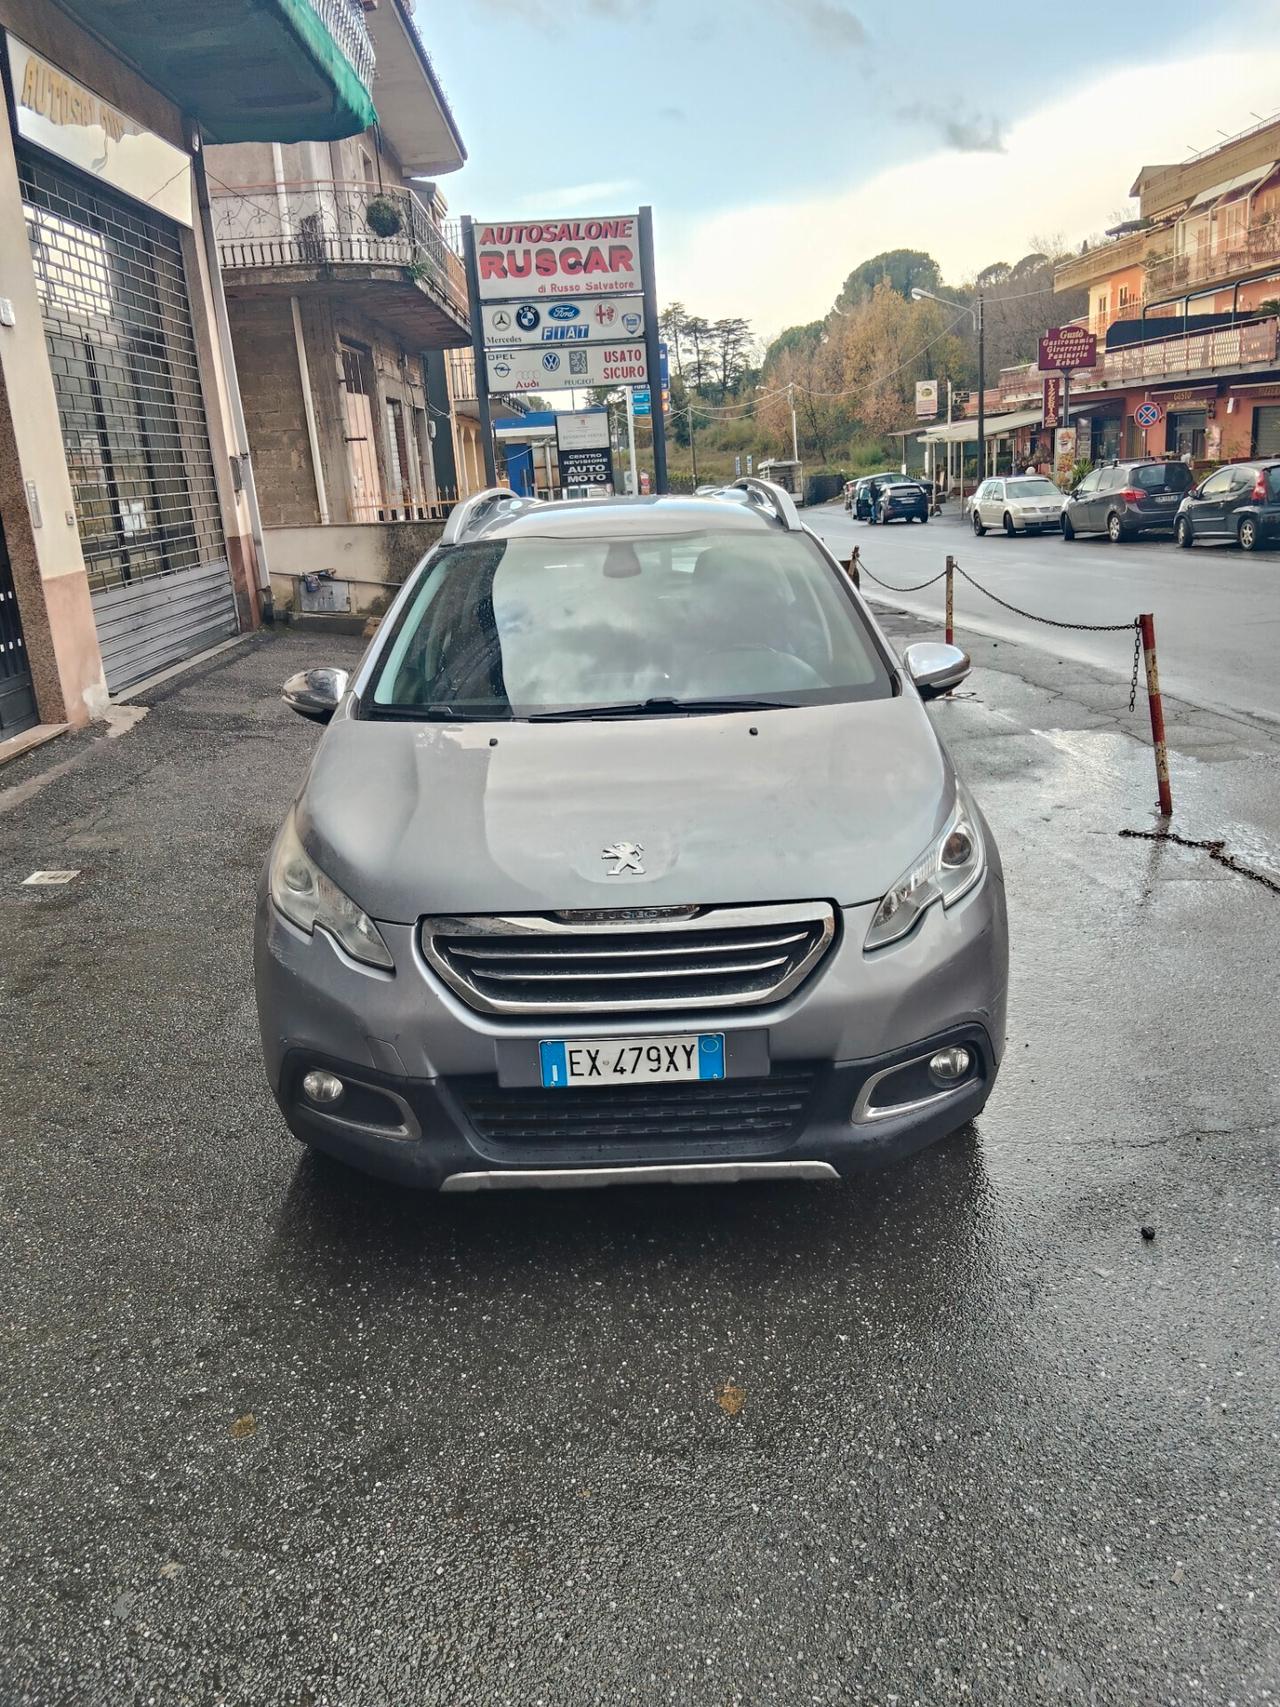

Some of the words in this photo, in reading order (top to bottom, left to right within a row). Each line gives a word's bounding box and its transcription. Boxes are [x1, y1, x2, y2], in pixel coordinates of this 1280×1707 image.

[479, 219, 635, 246] AUTOSALONE
[478, 245, 635, 280] RUSCAR
[537, 283, 546, 294] di
[550, 283, 581, 293] Russo
[585, 281, 635, 291] Salvatore
[553, 306, 575, 318] Ford
[543, 325, 588, 340] FIAT
[486, 336, 522, 344] Mercedes
[1042, 336, 1094, 346] Gastronomia
[1046, 344, 1089, 353] Girarrosto
[487, 353, 516, 361] OPEL
[604, 349, 642, 363] USATO
[1047, 351, 1088, 360] Panineria
[1055, 358, 1080, 366] Kebab
[603, 365, 645, 380] SICURO
[516, 379, 540, 389] Audi
[564, 378, 594, 386] PEUGEOT
[568, 452, 602, 460] CENTRO
[567, 464, 606, 474] AUTO
[567, 474, 607, 483] MOTO
[583, 909, 672, 921] PEUGEOT
[568, 1048, 602, 1077] EX
[612, 1044, 696, 1075] 479XY
